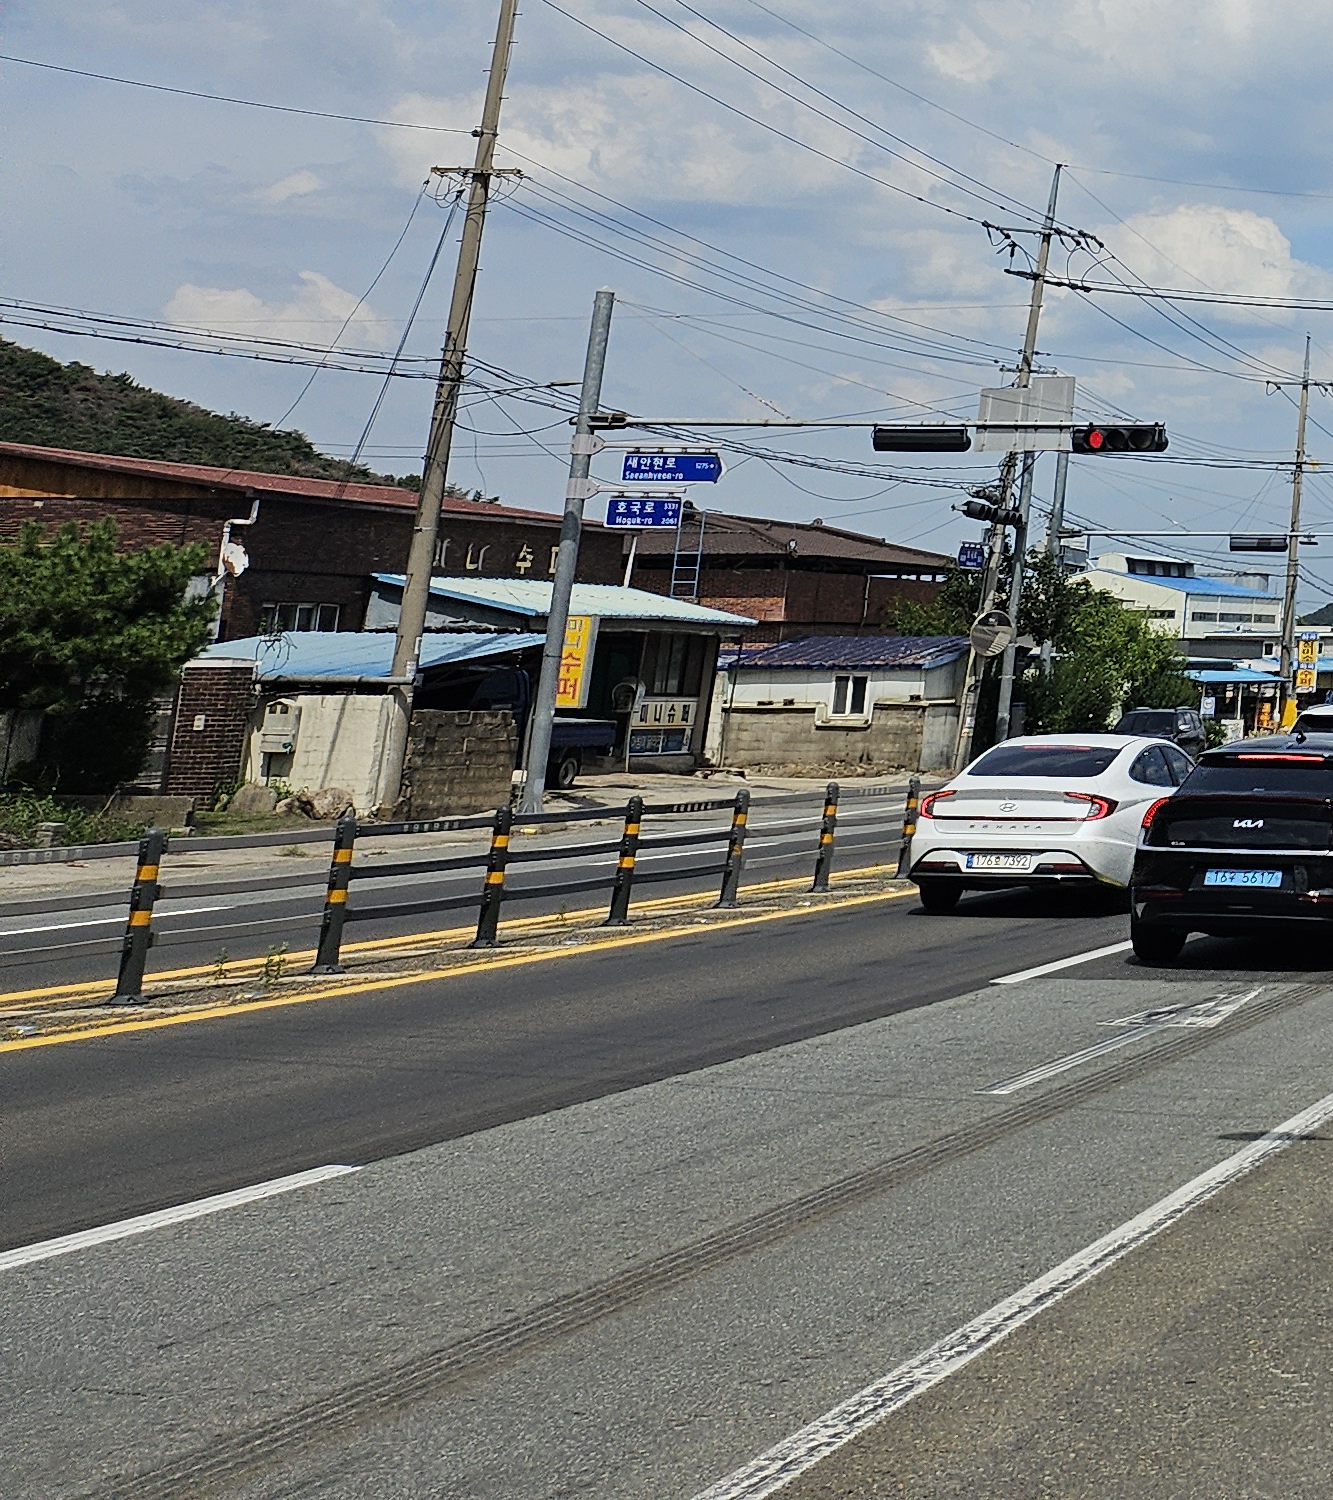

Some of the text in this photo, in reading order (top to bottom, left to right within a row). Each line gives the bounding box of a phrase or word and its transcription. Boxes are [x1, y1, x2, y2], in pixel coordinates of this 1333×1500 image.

[626, 456, 677, 470] 새안현로
[615, 501, 656, 515] 호국로
[615, 516, 653, 526] Hoguk-ro
[1232, 819, 1264, 829] KIA
[1003, 854, 1028, 867] 7392
[1241, 871, 1276, 884] 5617
